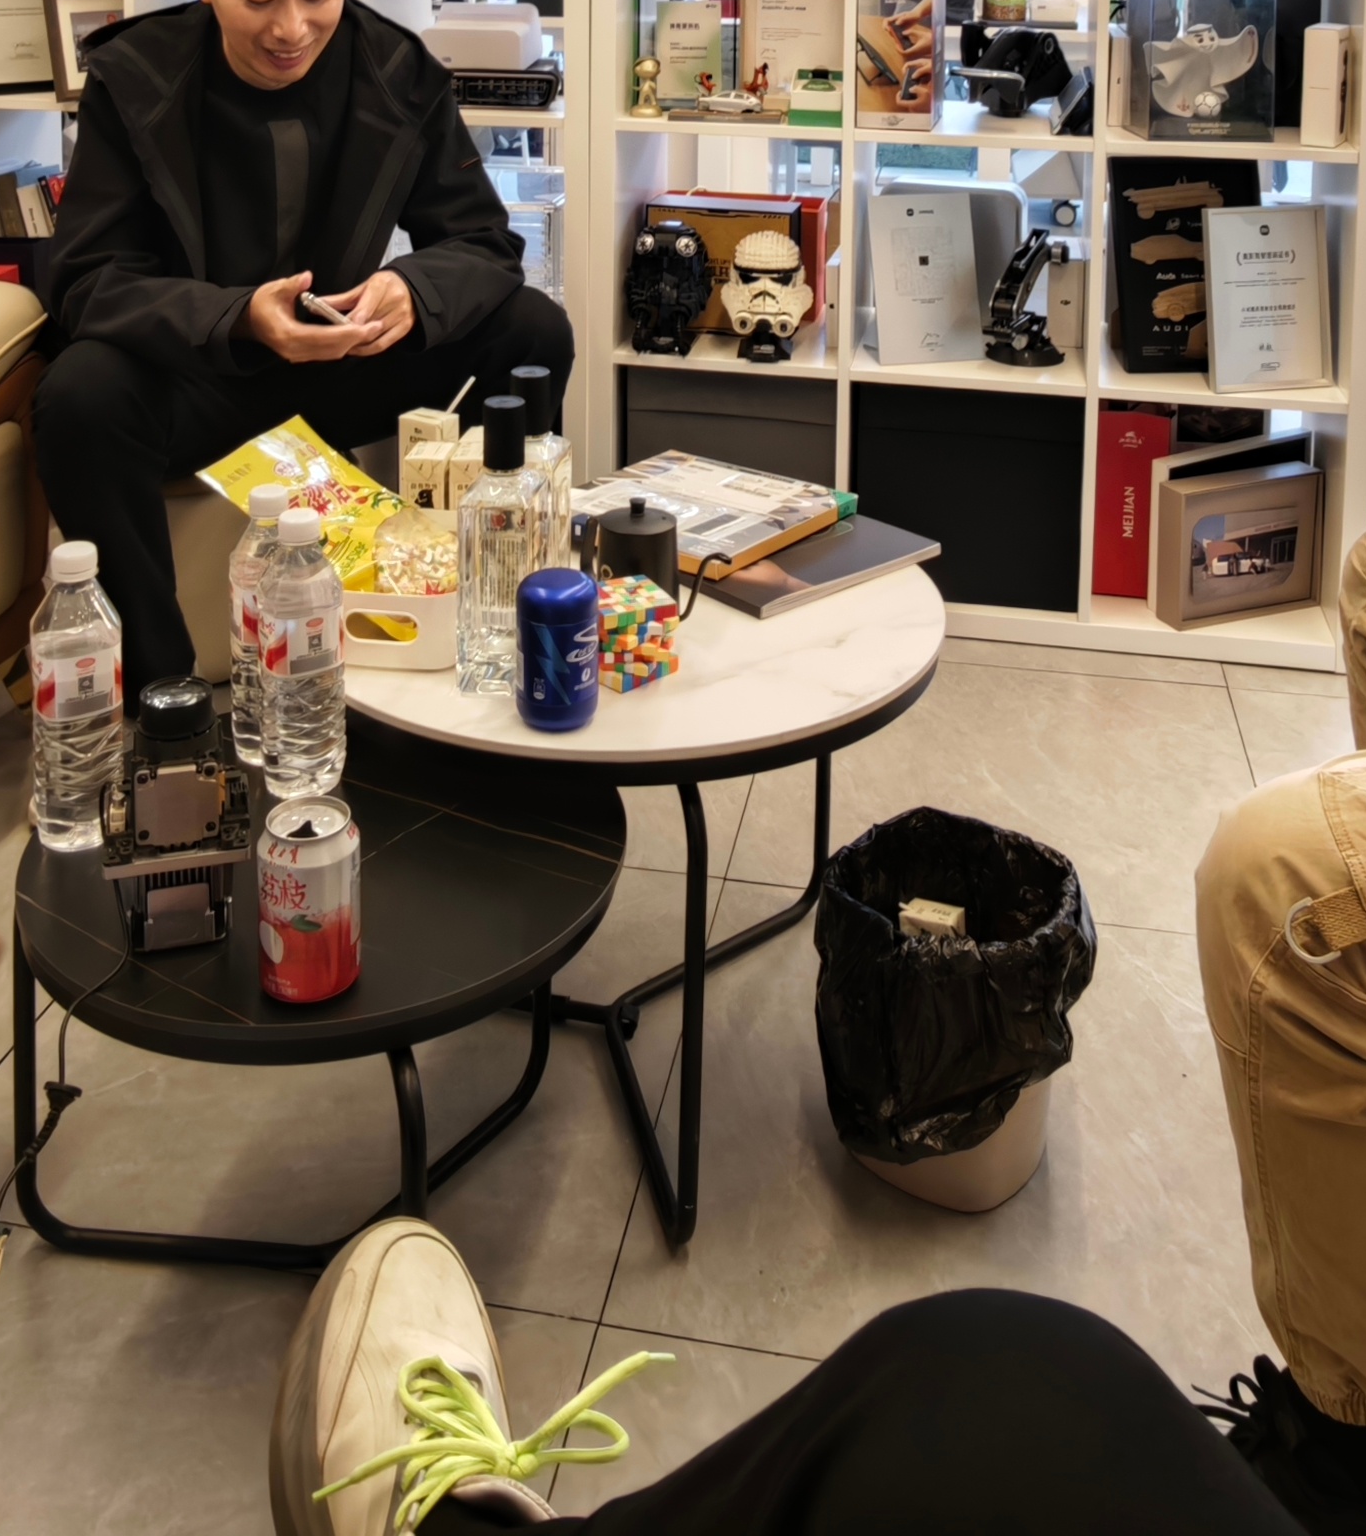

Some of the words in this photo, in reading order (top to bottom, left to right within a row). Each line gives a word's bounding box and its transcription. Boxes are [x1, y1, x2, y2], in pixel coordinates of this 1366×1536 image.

[1155, 272, 1177, 281] Audi
[1152, 324, 1189, 332] AUDI
[1122, 486, 1135, 538] MEIJIAN
[260, 869, 311, 911] 荔枝
